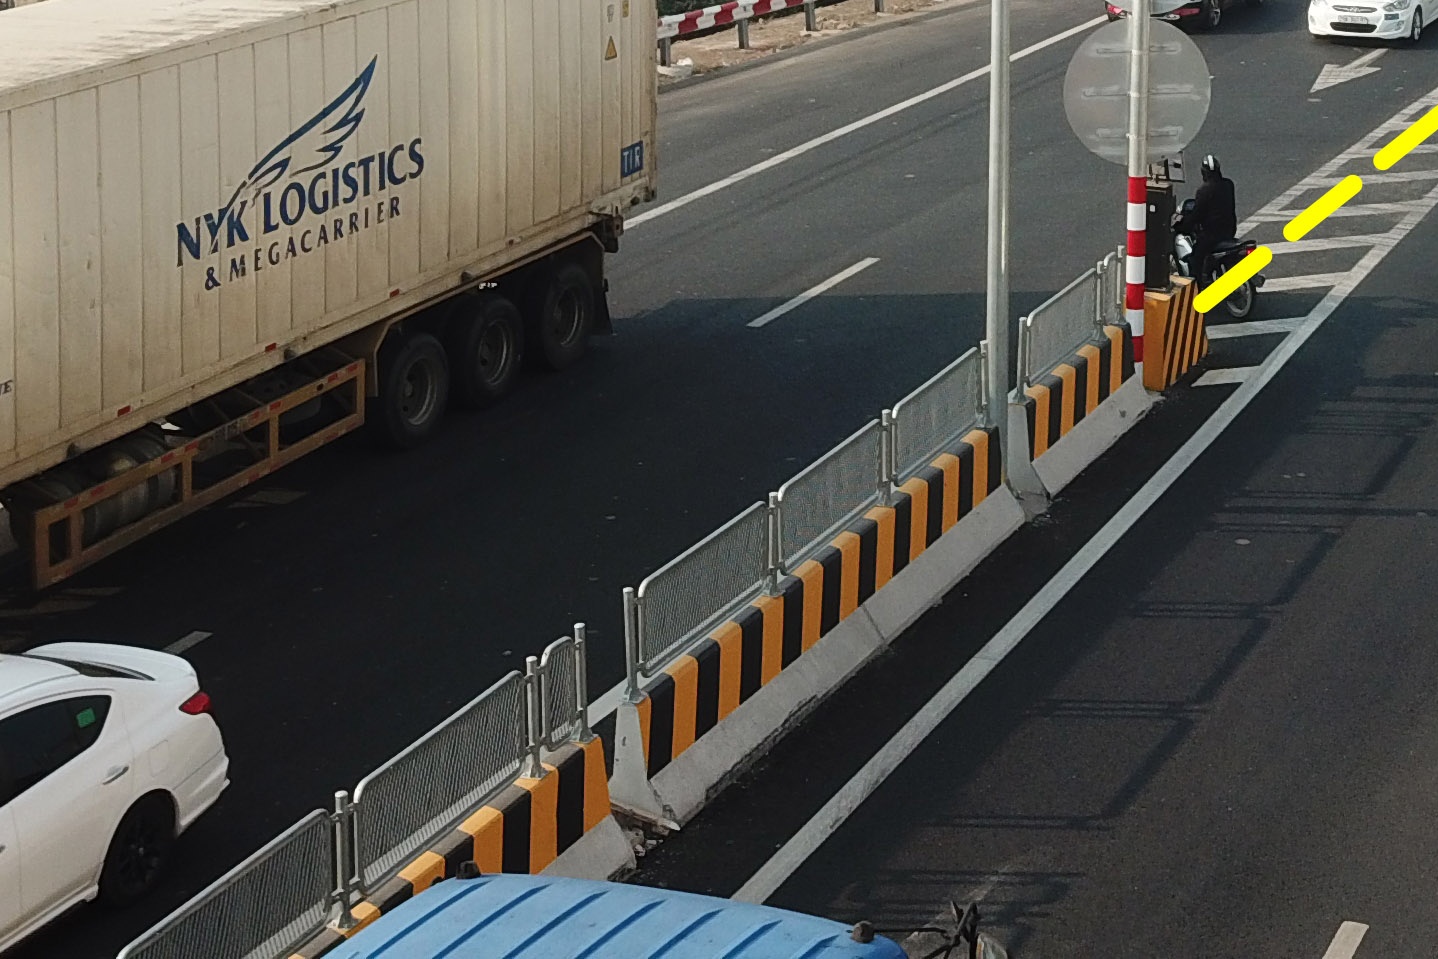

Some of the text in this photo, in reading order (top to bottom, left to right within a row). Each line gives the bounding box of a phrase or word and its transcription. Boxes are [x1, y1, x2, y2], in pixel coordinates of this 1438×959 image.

[176, 137, 425, 267] NYK LOGISTICS
[622, 146, 641, 173] TIR
[204, 196, 400, 291] & MEGACARRIER
